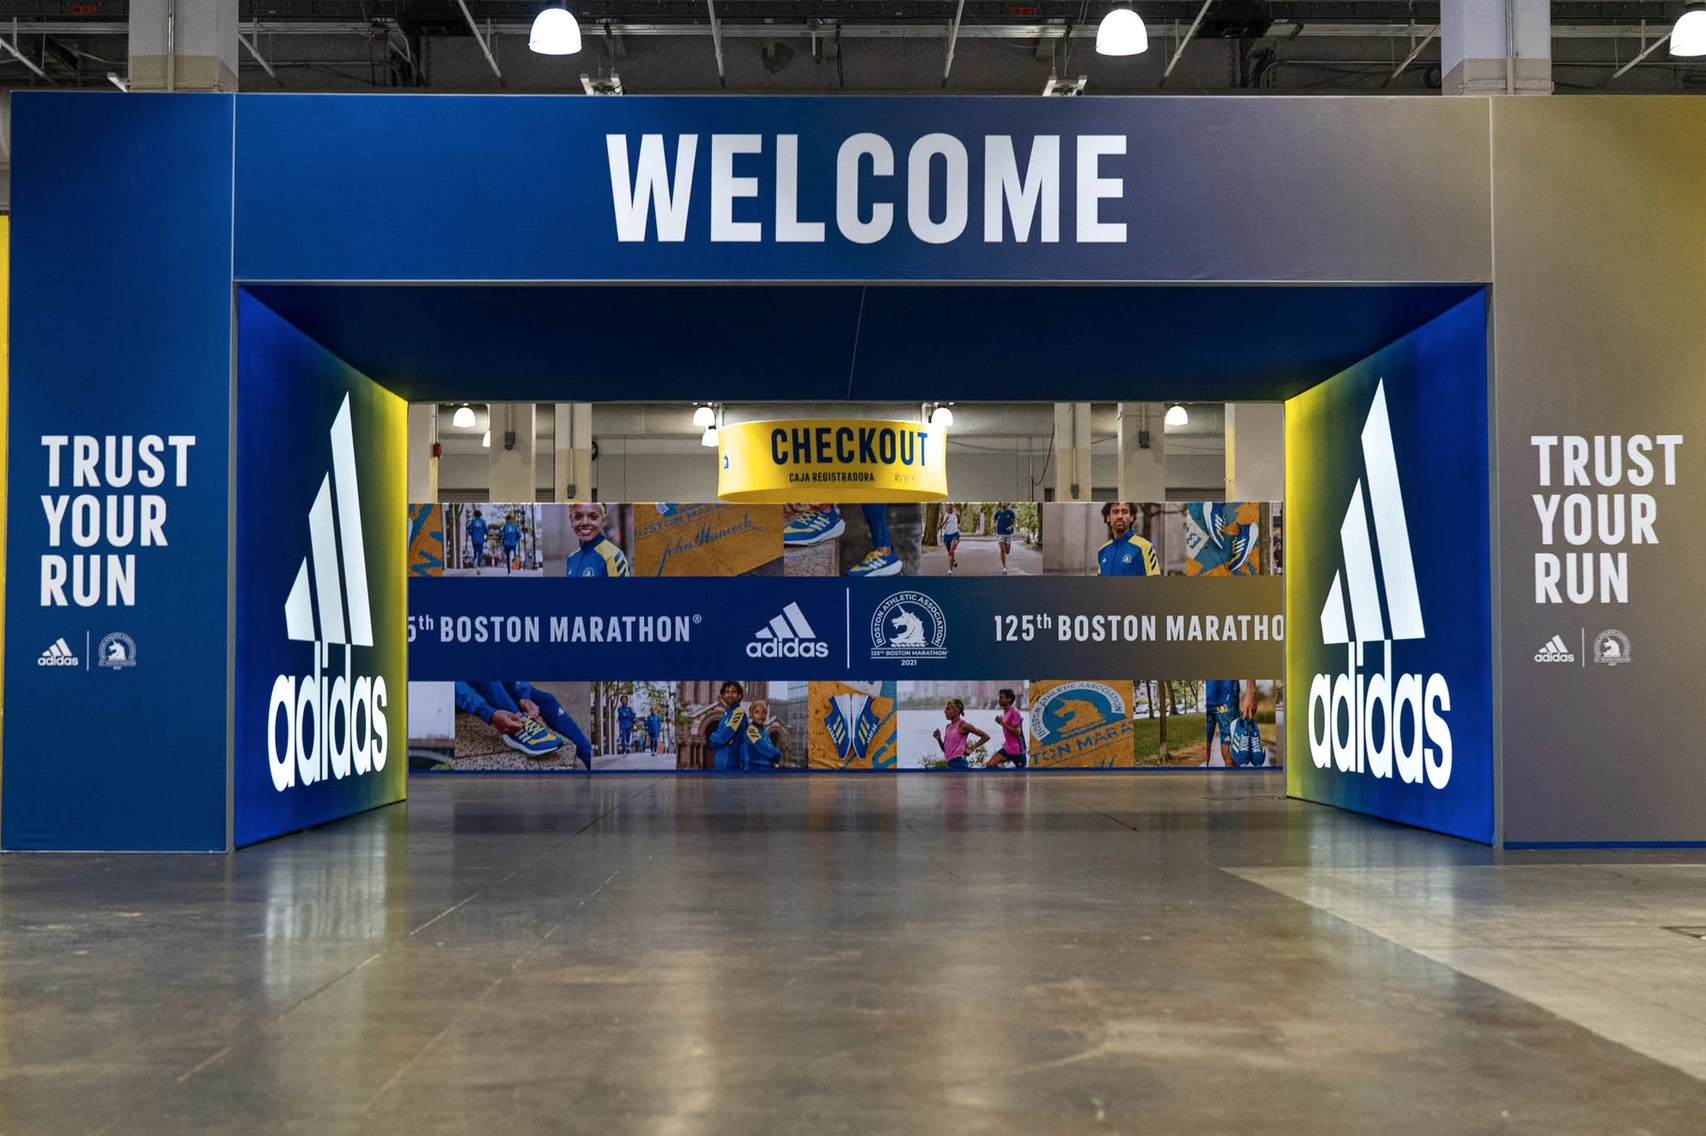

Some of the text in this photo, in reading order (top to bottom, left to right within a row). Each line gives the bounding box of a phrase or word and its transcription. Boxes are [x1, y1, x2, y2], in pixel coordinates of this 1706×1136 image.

[605, 132, 1128, 244] WELCOME
[41, 434, 196, 488] TRUST
[771, 427, 928, 467] CHECKOUT
[1530, 434, 1684, 487] TRUST
[789, 472, 875, 483] CAJA REGISTRADORA
[40, 494, 168, 548] YOUR
[1532, 493, 1659, 546] YOUR
[40, 554, 136, 607] RUN
[1534, 552, 1629, 605] RUN
[440, 616, 540, 643] BOSTON
[550, 613, 702, 642] MARATHON®
[873, 593, 944, 645] BOSTON ATHLETIC ASSOCIATION
[994, 613, 1285, 642] 125th BOSTON MARATHO
[37, 655, 79, 666] adidas
[746, 636, 829, 658] adidas
[1534, 652, 1575, 663] adidas
[268, 641, 388, 792] adidas
[1308, 640, 1453, 790] adidas
